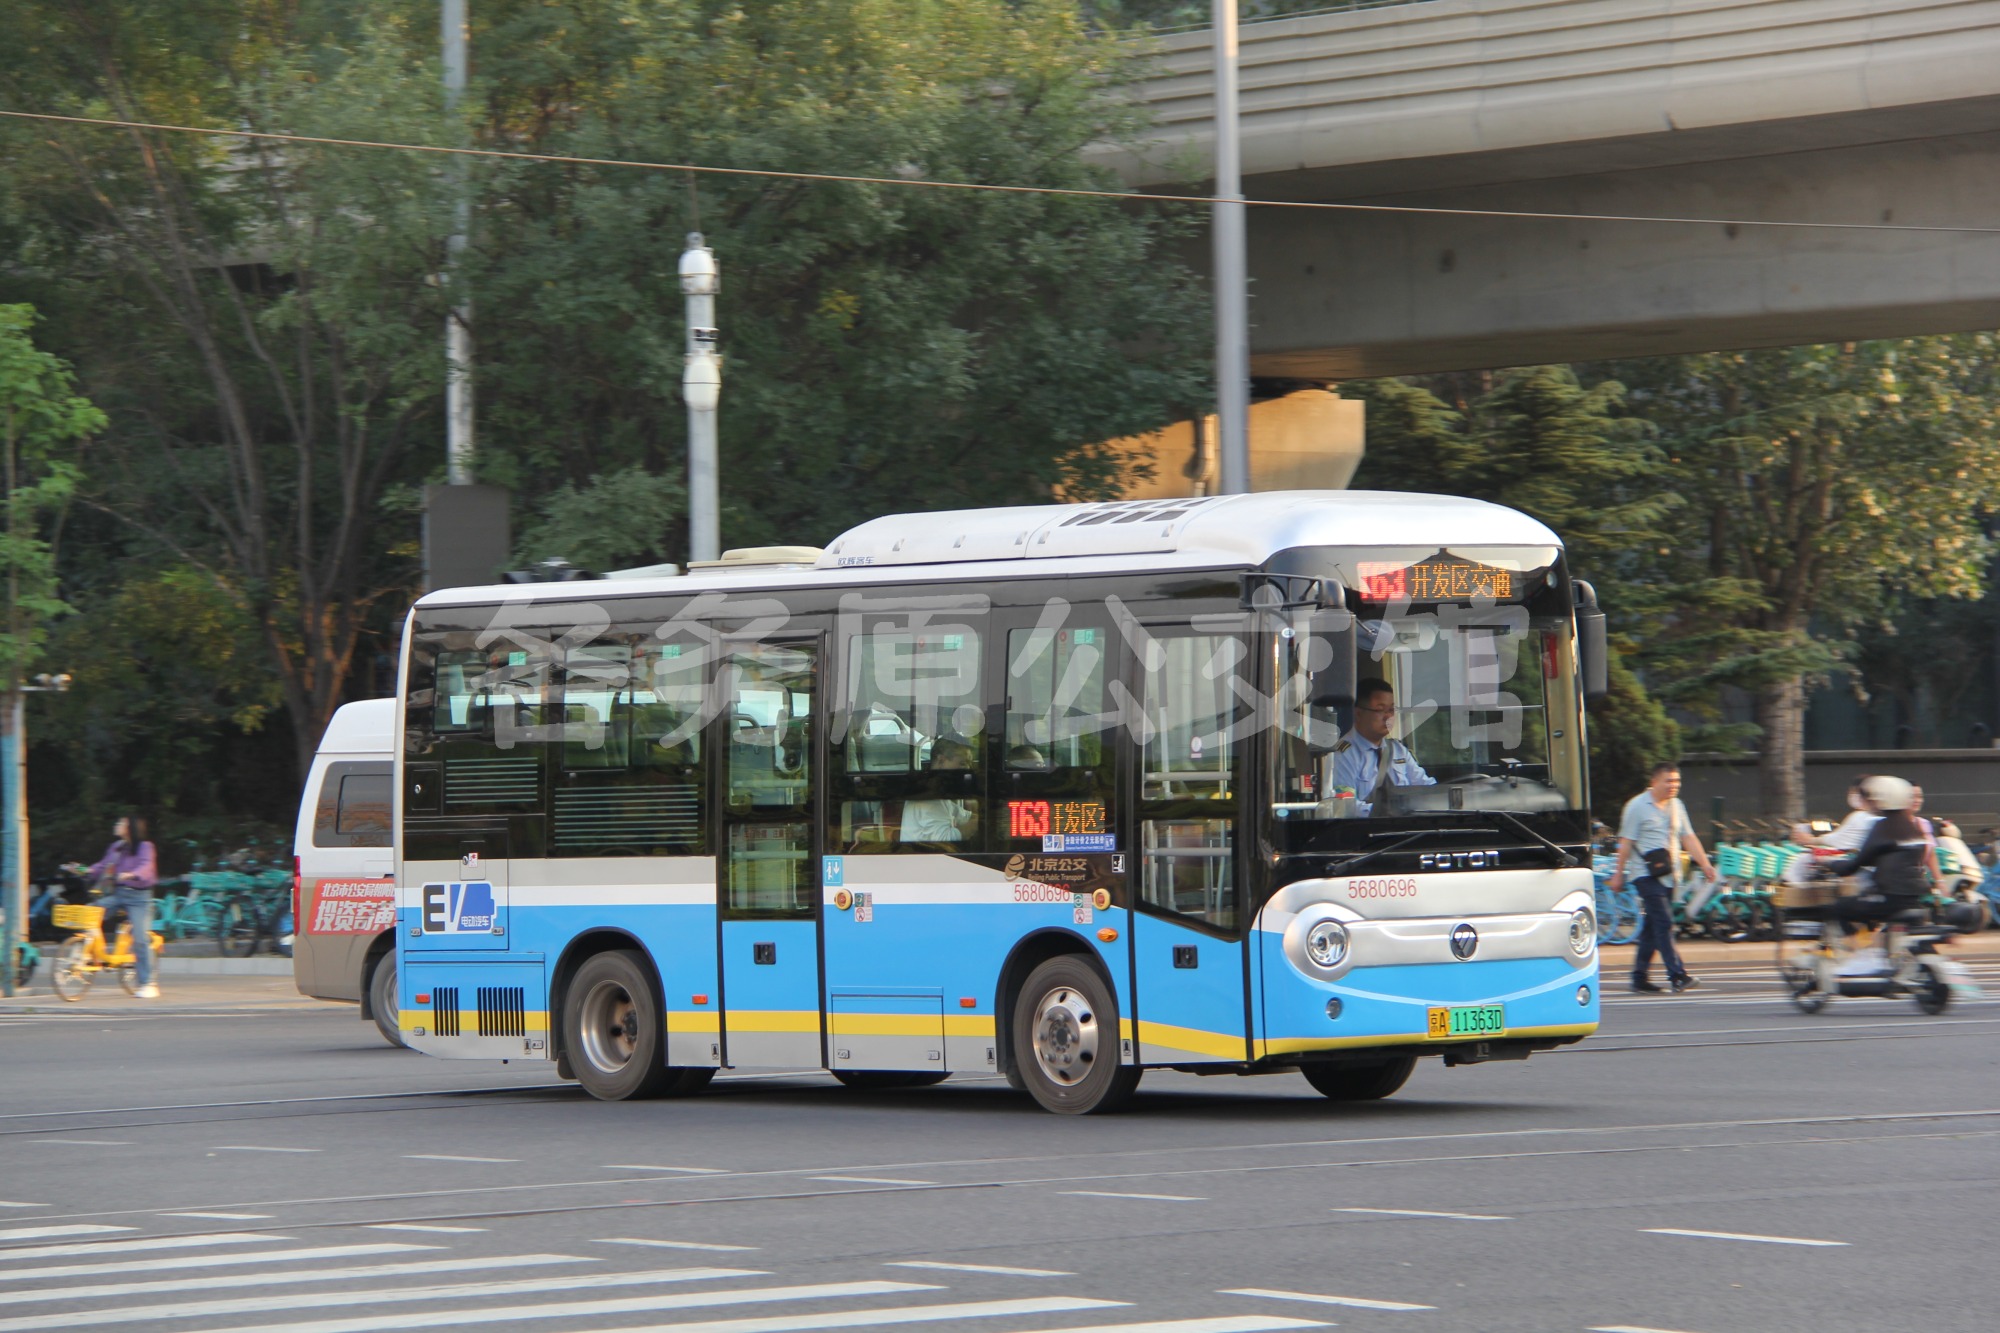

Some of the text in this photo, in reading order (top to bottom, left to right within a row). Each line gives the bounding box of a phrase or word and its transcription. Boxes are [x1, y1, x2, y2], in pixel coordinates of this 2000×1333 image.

[1411, 563, 1512, 599] 开发区交通
[1008, 801, 1050, 837] T63
[1028, 858, 1087, 871] 北京公交
[1419, 851, 1500, 870] FOTON
[1045, 873, 1060, 881] Public
[1061, 873, 1086, 882] Transport
[1014, 883, 1070, 902] 5680696
[1348, 879, 1417, 899] 5680696
[461, 915, 489, 927] 电动汽车
